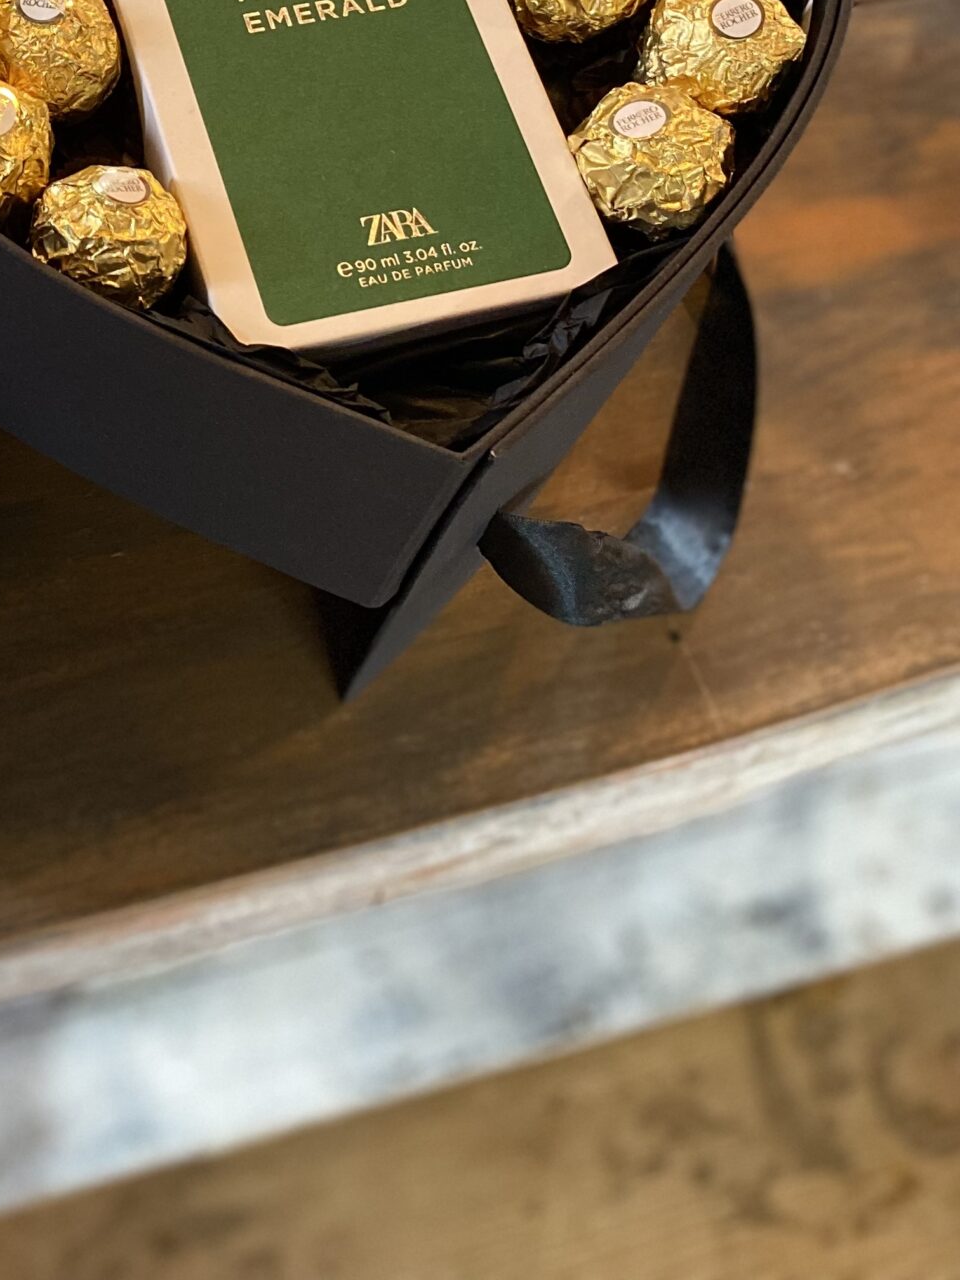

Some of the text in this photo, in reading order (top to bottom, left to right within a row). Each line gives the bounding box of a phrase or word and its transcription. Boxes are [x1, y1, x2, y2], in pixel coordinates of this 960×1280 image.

[720, 10, 758, 30] ROCHER
[616, 106, 659, 127] FERRERO
[620, 112, 663, 133] ROCHER
[359, 207, 439, 247] ZARA
[381, 253, 401, 269] ml
[402, 246, 438, 264] 3.04
[441, 243, 457, 256] fl.
[459, 240, 483, 253] oz.
[358, 256, 473, 288] EAU DE PARFUM
